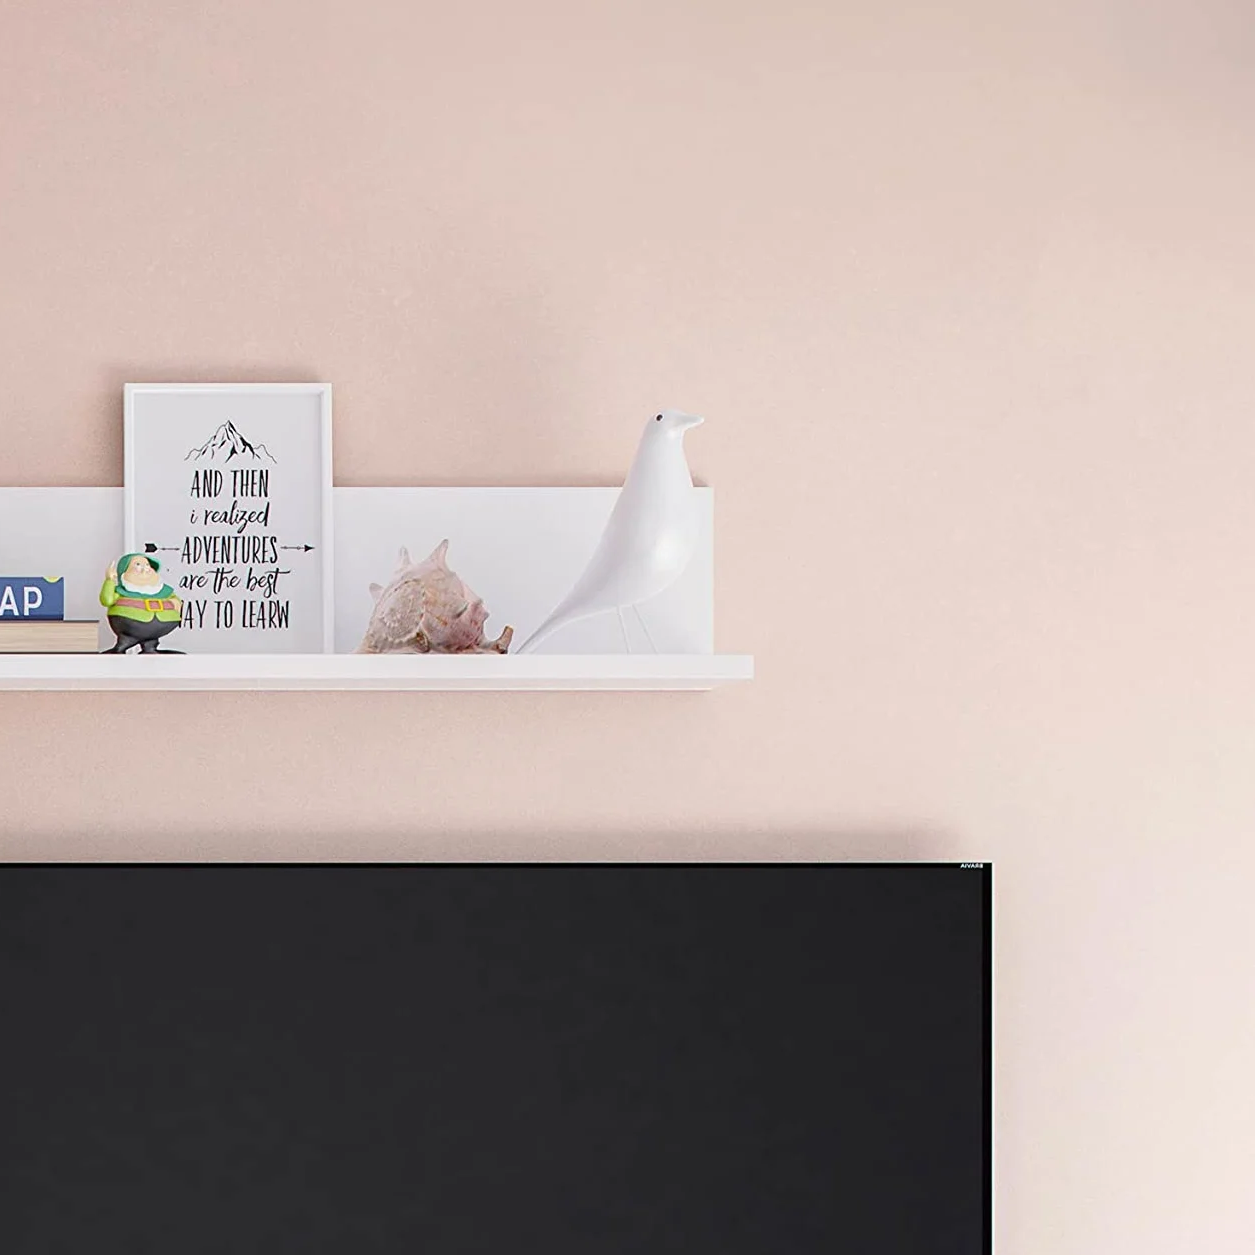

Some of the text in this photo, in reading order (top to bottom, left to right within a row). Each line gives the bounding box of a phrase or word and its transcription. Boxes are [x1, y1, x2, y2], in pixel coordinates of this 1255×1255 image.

[190, 469, 269, 498] AND THEN
[203, 500, 270, 534] realized
[181, 535, 278, 565] ADVENTURES
[179, 567, 291, 599] are the best
[214, 600, 234, 629] TO
